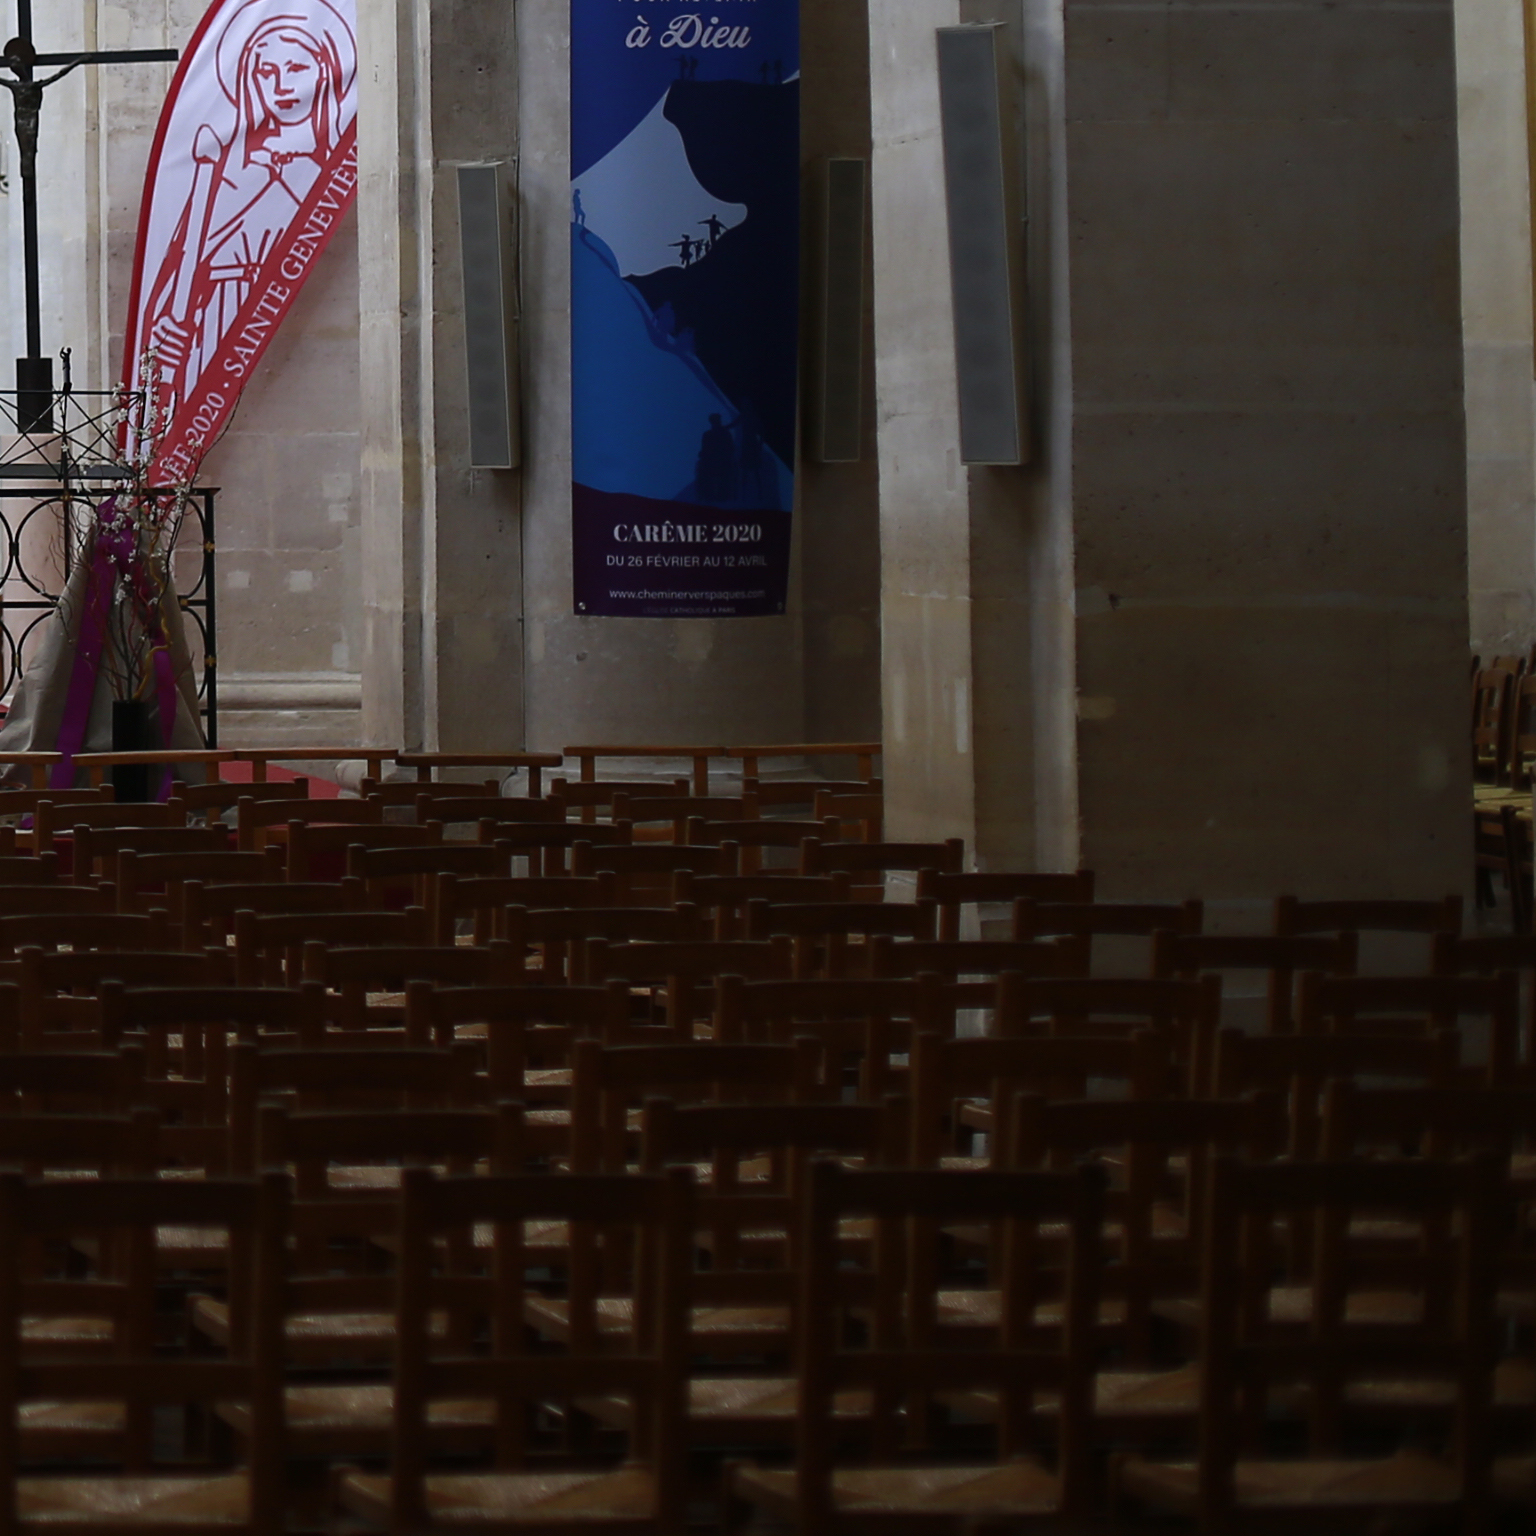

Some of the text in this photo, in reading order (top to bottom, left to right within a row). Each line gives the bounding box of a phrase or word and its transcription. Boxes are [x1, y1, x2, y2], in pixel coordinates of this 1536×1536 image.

[625, 13, 751, 48] à Dieu
[185, 392, 226, 445] 2020
[223, 280, 291, 378] SAINTE
[280, 138, 358, 281] GENEVIÈV
[613, 520, 762, 543] CARÊME 2020
[606, 553, 767, 567] DU 26 FÉVRIER AU 12 AVRIL
[609, 588, 766, 601] www.cheminerverspaques.com
